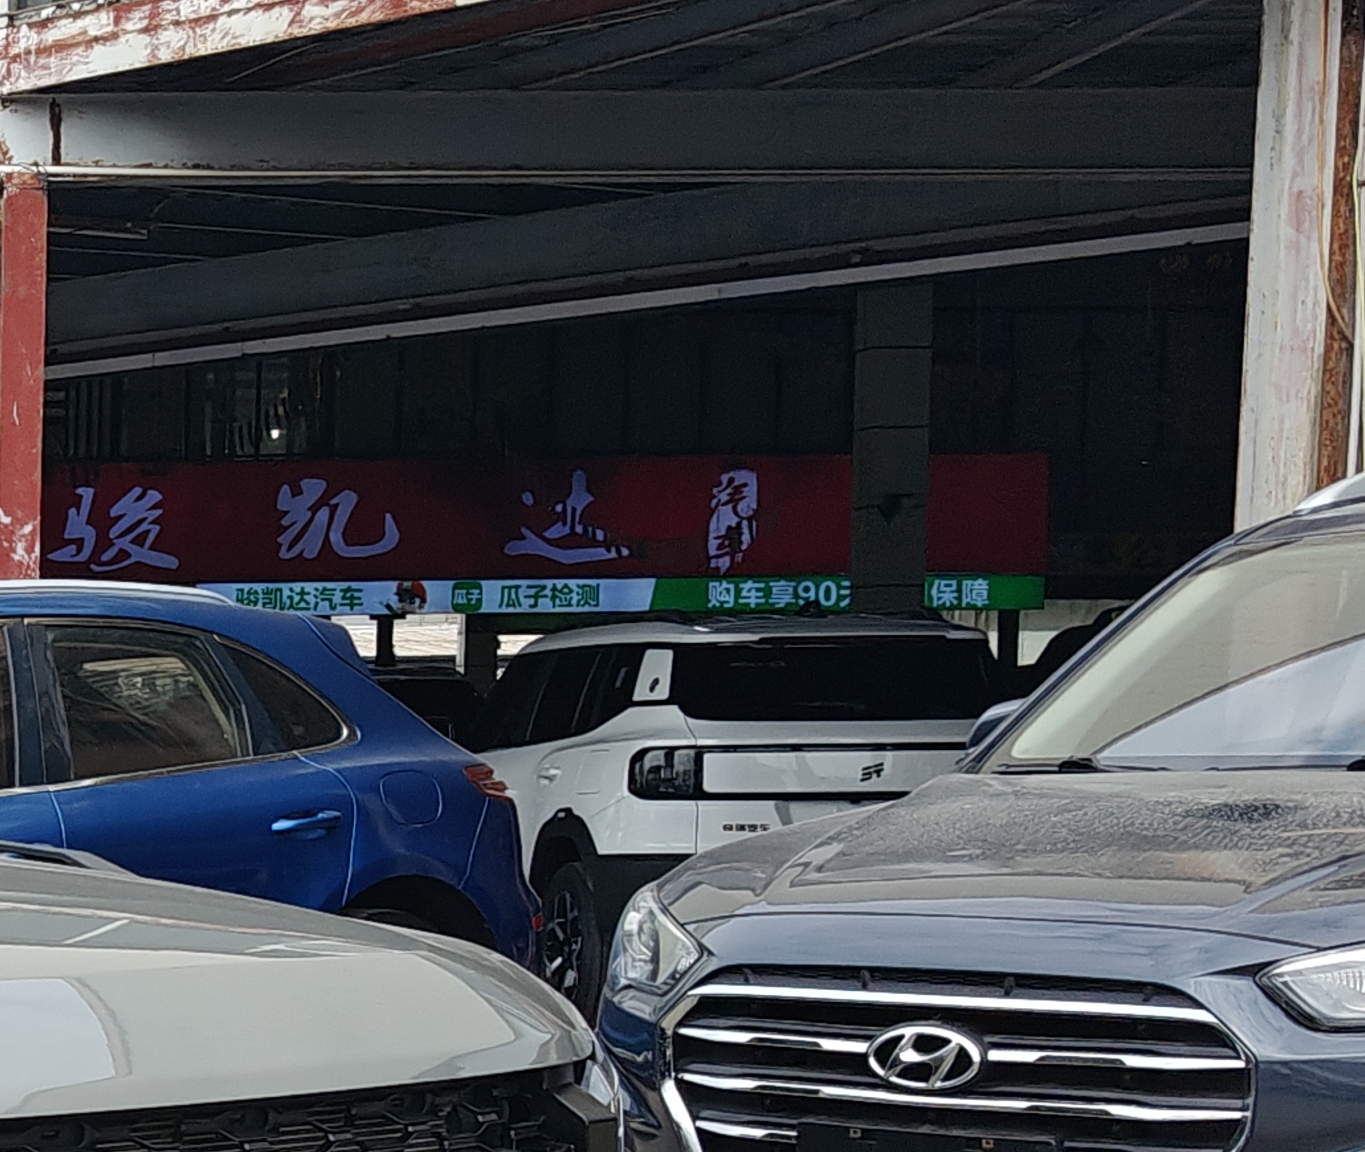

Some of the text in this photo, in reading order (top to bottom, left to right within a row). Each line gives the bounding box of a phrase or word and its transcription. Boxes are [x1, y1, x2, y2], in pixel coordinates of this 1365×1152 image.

[235, 586, 364, 611] 骏凯达汽车
[498, 583, 600, 608] 瓜子检测
